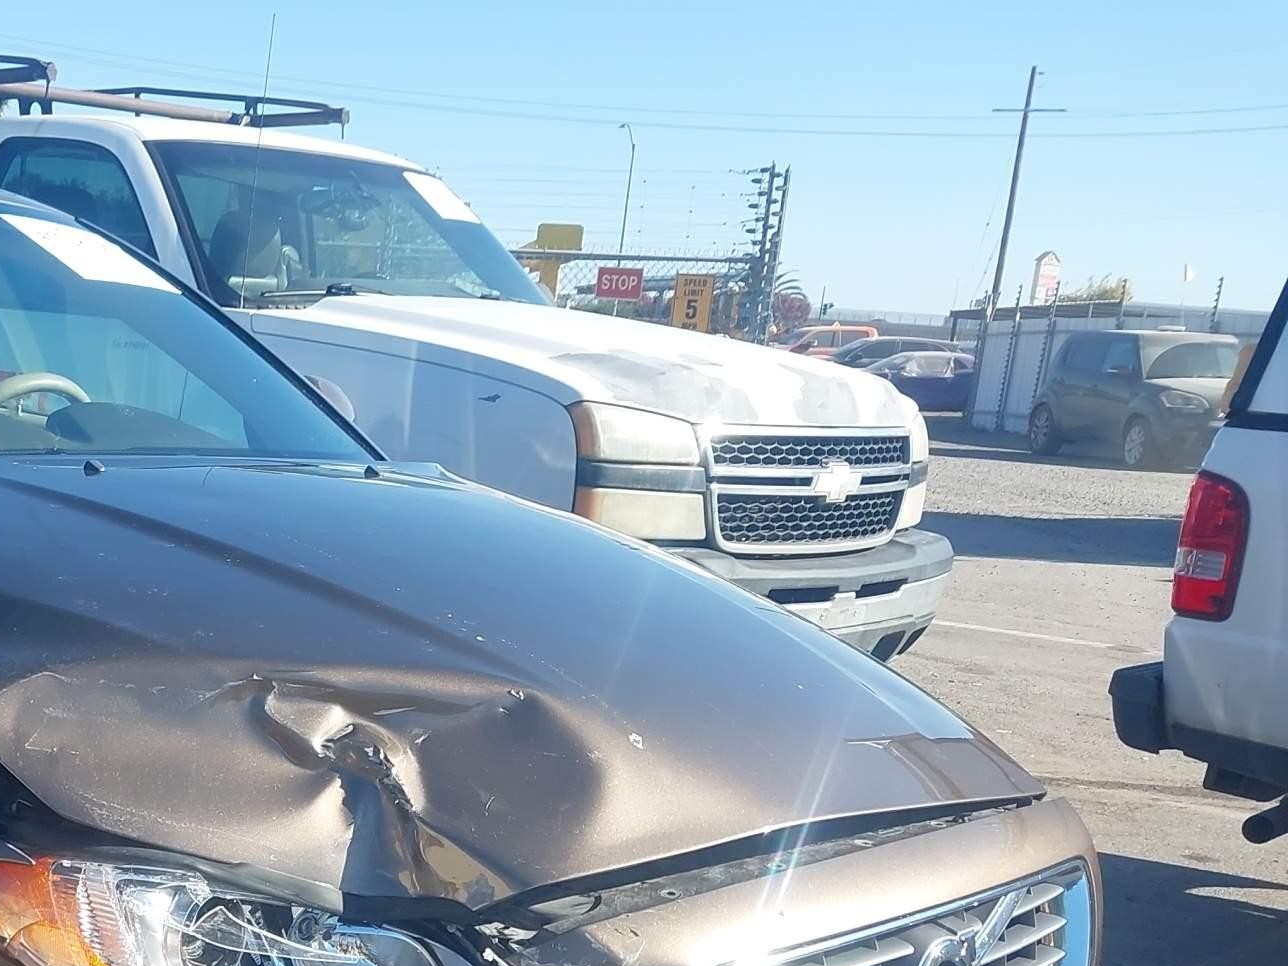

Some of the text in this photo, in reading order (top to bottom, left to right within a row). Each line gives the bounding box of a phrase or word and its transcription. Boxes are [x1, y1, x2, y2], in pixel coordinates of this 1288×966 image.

[601, 274, 638, 291] STOP
[683, 278, 708, 287] SPEED
[683, 288, 704, 297] LIMIT
[685, 299, 698, 320] 5
